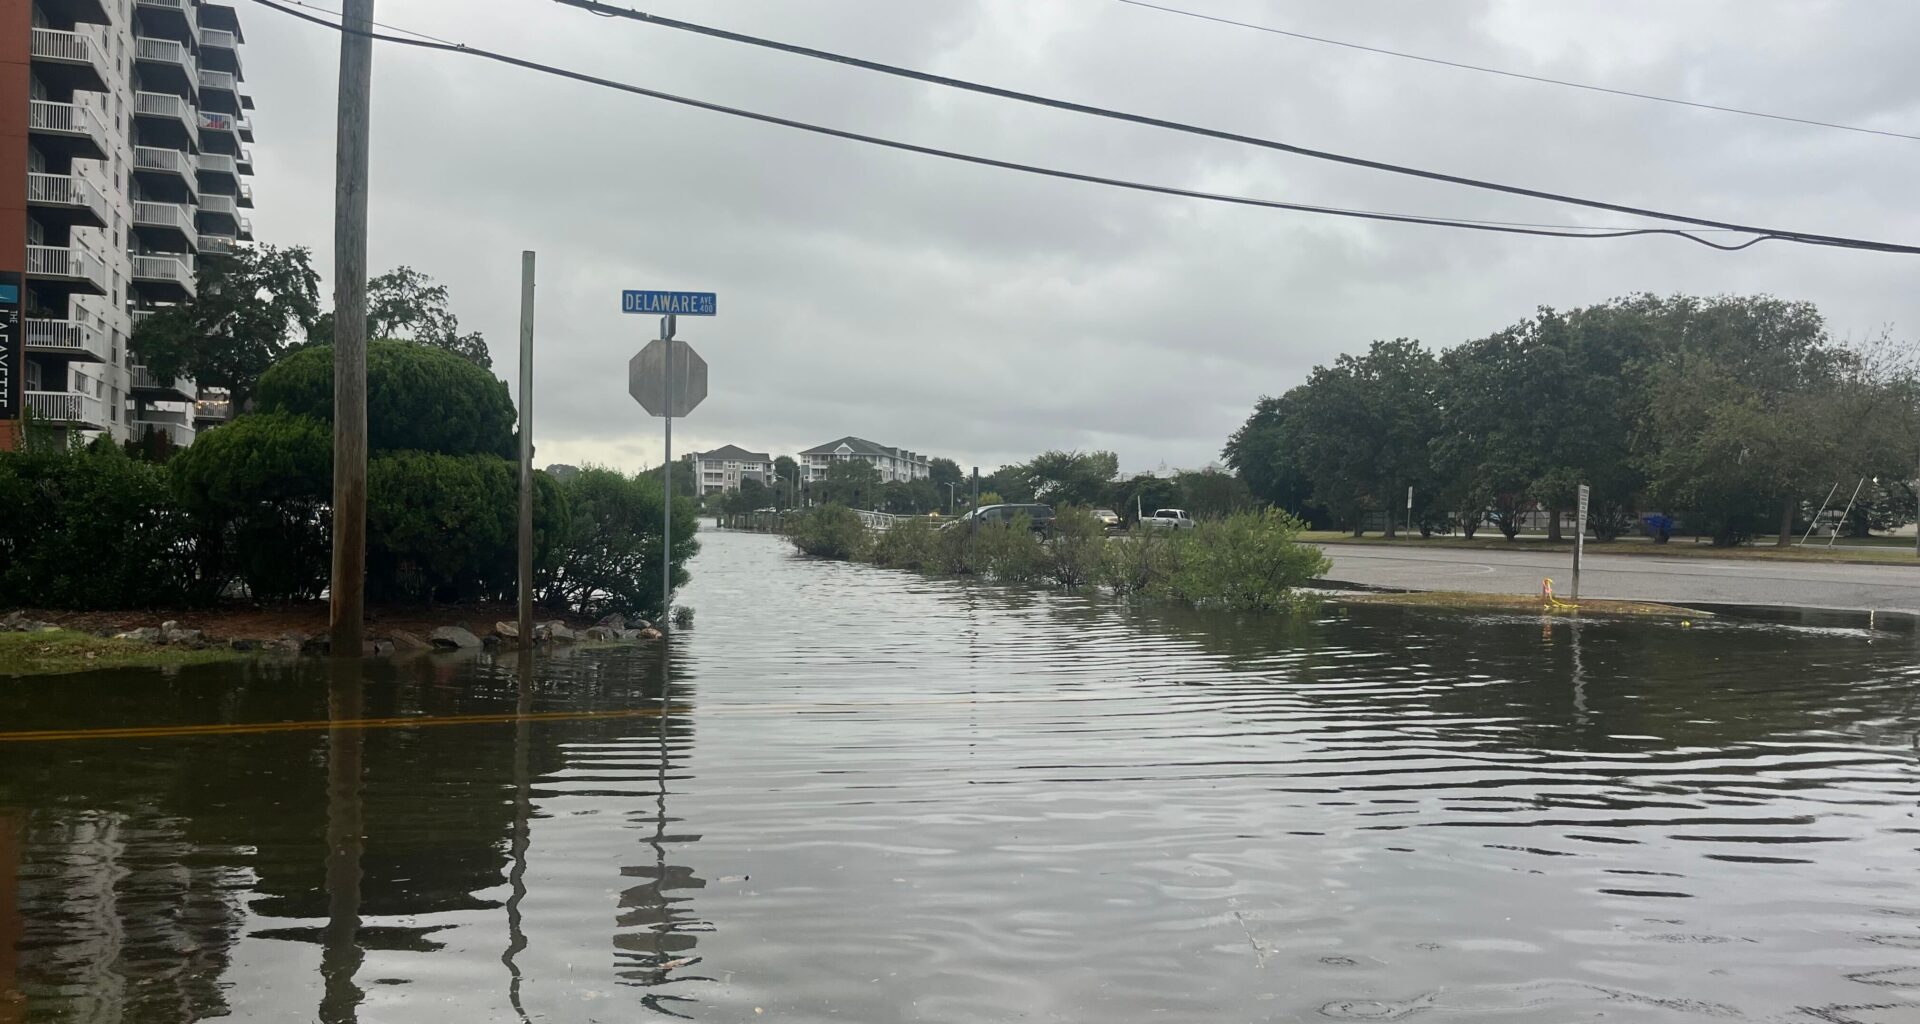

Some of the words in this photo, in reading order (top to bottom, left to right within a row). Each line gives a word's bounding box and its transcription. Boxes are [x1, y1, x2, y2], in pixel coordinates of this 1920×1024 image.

[626, 294, 698, 312] DELAWARE
[700, 296, 712, 305] AVE
[700, 305, 713, 313] 400
[10, 310, 18, 323] THE
